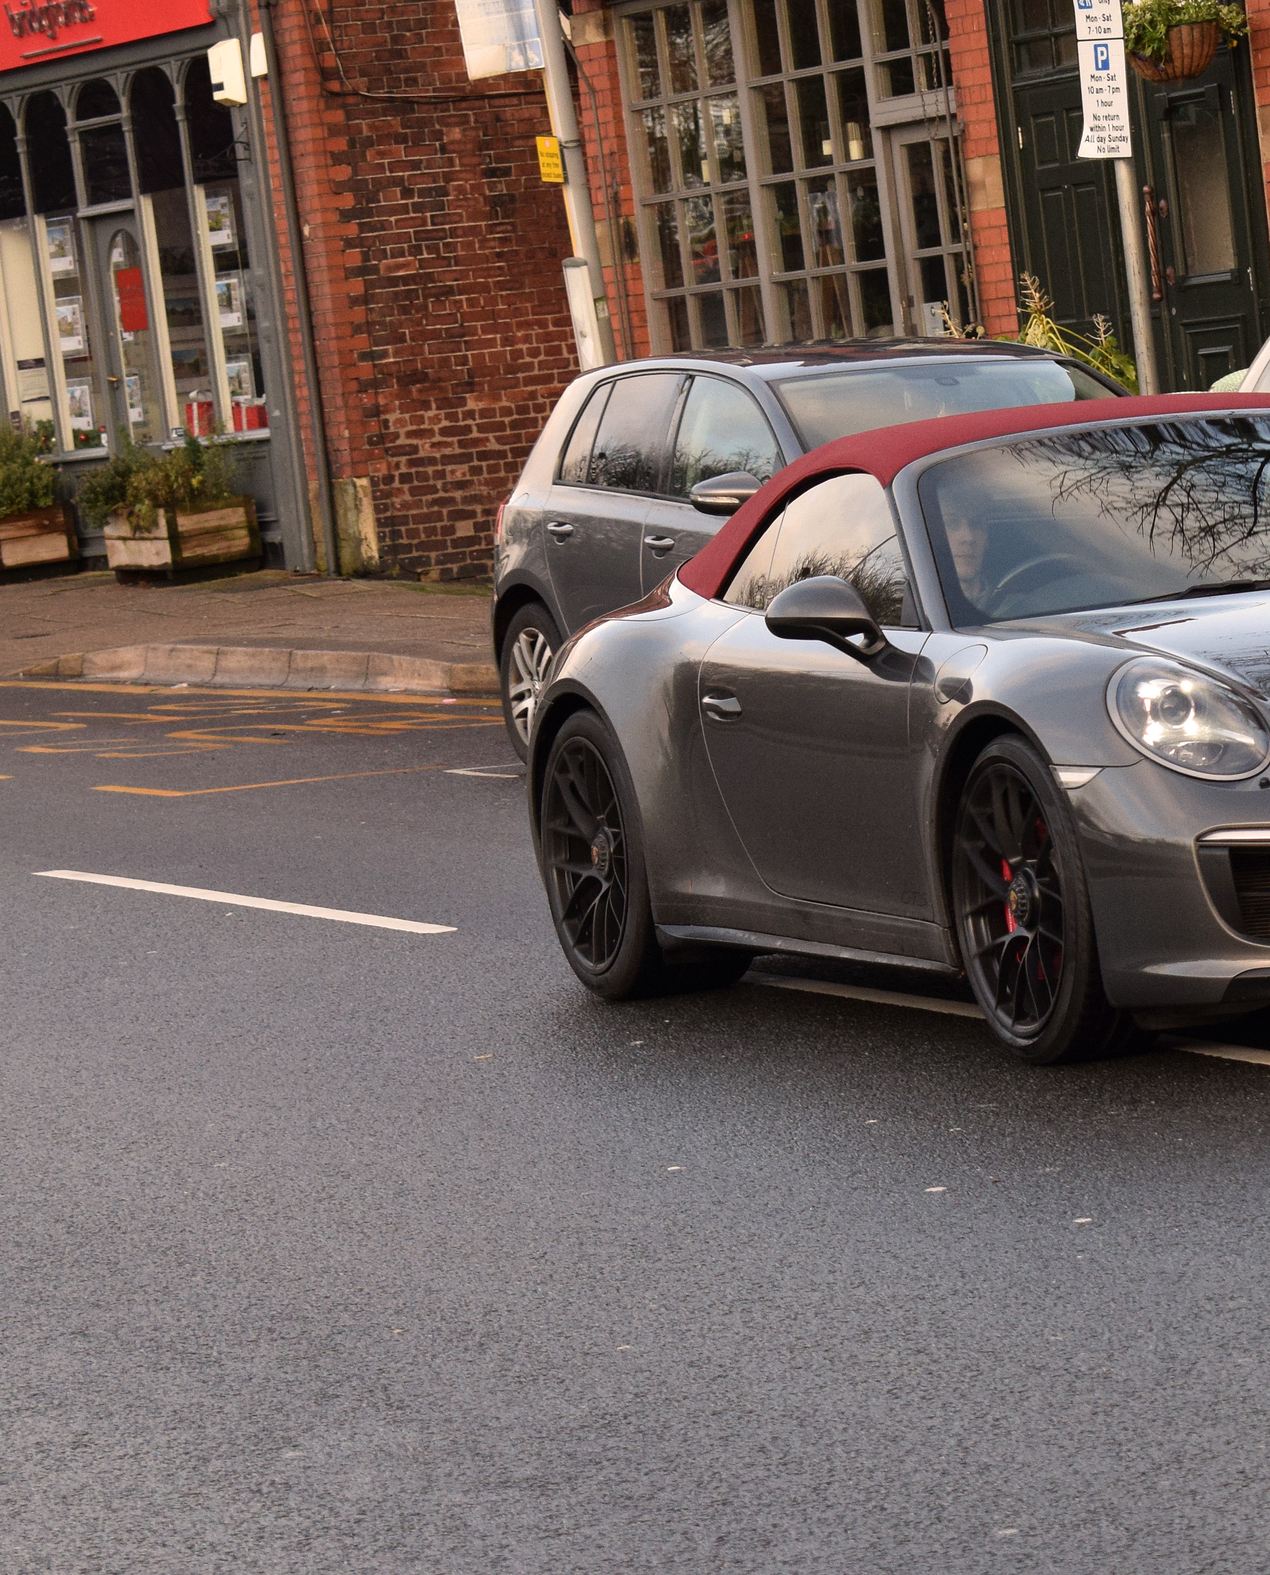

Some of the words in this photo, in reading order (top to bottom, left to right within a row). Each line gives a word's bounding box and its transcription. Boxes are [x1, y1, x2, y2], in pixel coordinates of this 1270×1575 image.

[1085, 14, 1098, 22] Mon
[1102, 13, 1112, 22] Sat
[1097, 46, 1107, 69] P
[1090, 74, 1102, 82] Mon
[1106, 73, 1117, 81] Sat
[1096, 99, 1099, 107] 1
[1101, 99, 1113, 107] hour
[1092, 113, 1101, 121] No
[1102, 113, 1120, 121] return
[1089, 124, 1106, 132] within
[1084, 134, 1095, 143] All
[1096, 135, 1106, 144] day
[1107, 134, 1128, 143] Sunday
[1096, 145, 1105, 153] No
[1106, 144, 1120, 153] limit
